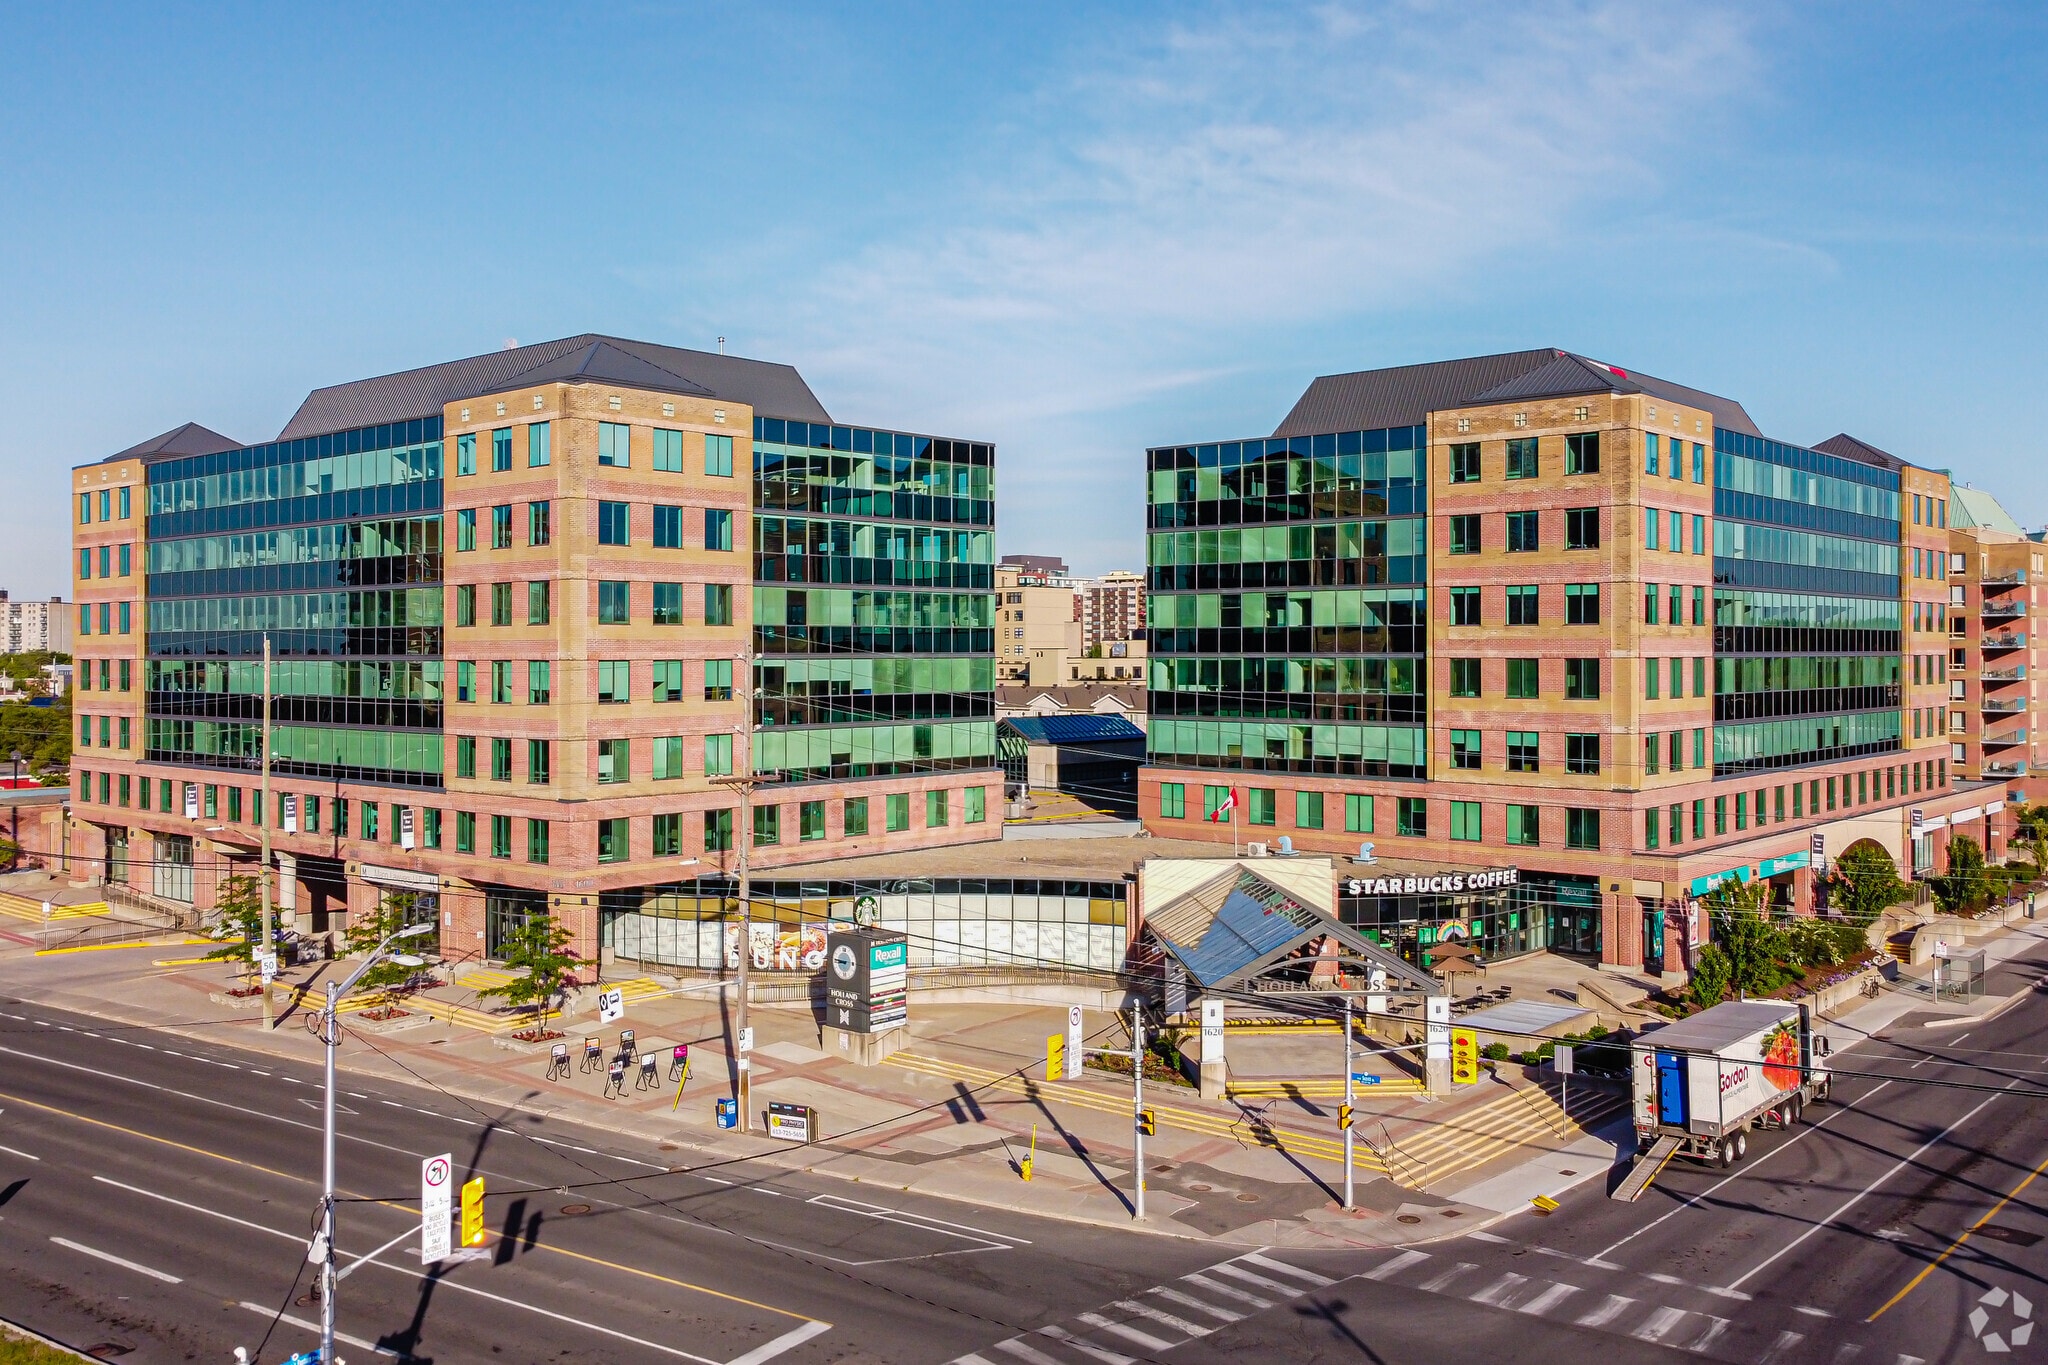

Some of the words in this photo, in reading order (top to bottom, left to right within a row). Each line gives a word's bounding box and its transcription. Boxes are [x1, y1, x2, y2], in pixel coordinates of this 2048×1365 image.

[1348, 875, 1464, 895] STARBUCKS
[1467, 869, 1518, 889] COFFEE
[875, 946, 902, 962] Rexall
[263, 961, 275, 970] 50
[830, 989, 858, 1000] HOLLAND
[835, 998, 854, 1008] CROSS
[1204, 1027, 1223, 1036] 1620
[1429, 1024, 1449, 1033] 1620
[1719, 1065, 1749, 1093] Gordon
